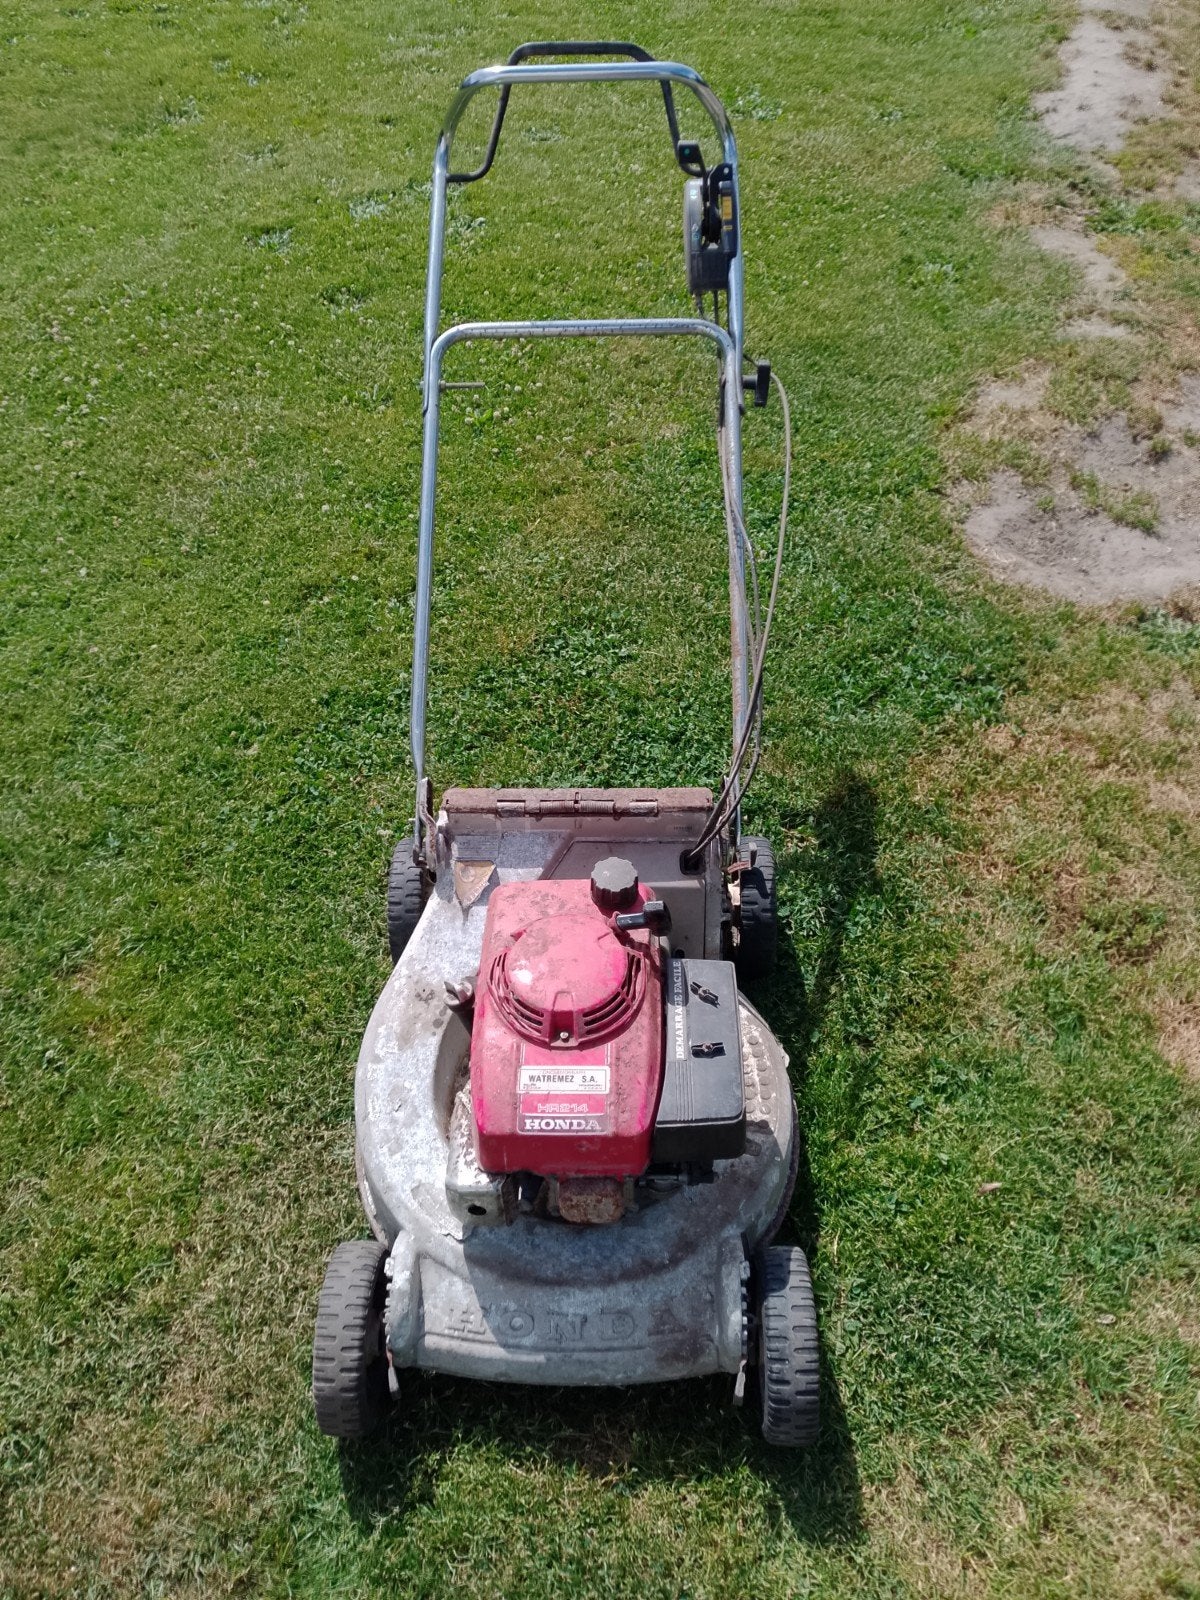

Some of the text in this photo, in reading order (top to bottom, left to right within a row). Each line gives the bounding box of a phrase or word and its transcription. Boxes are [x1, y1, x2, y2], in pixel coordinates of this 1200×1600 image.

[673, 961, 685, 1059] DEMARRAGE FACILE
[528, 1074, 598, 1083] WATREMEZ S.A.
[524, 1118, 602, 1131] HONDA
[444, 1307, 688, 1341] HONDA
